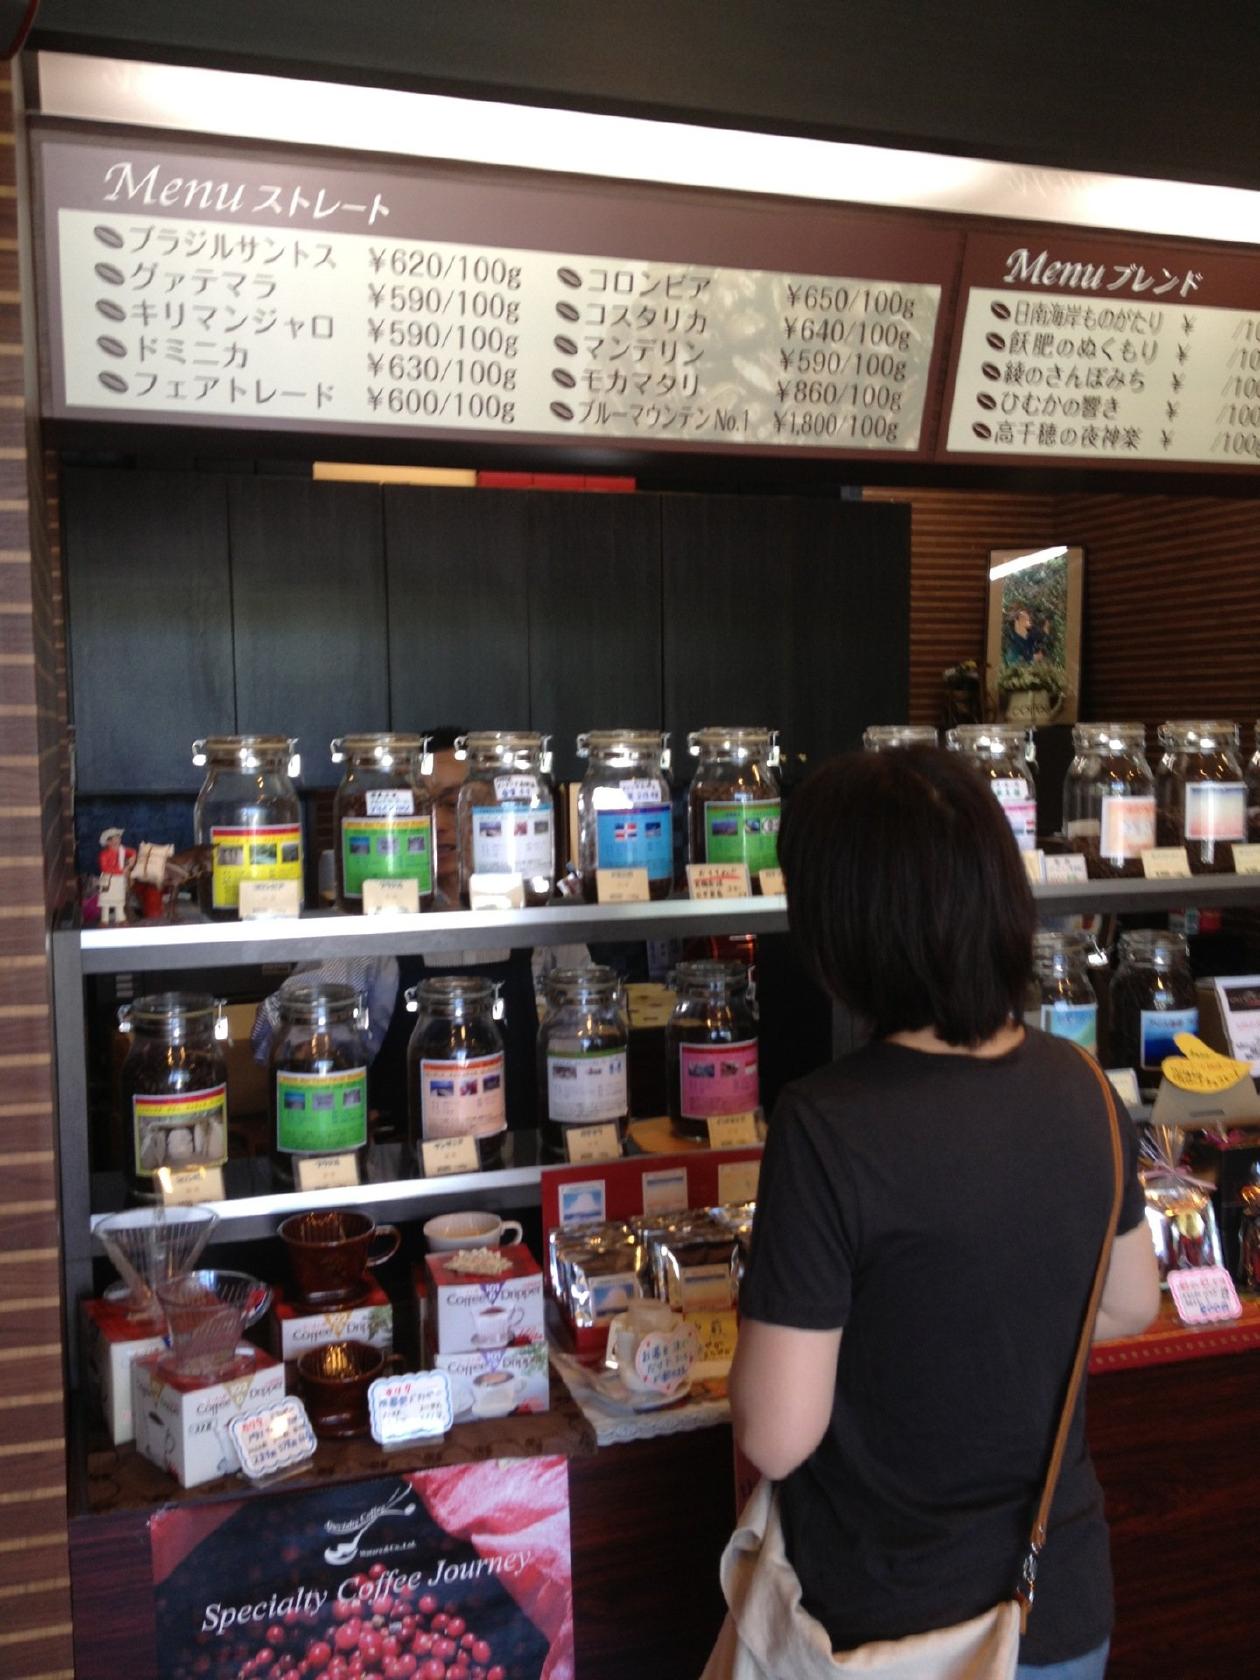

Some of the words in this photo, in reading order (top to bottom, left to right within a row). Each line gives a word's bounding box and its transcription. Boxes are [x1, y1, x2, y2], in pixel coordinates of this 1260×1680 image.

[104, 162, 247, 214] Menu
[252, 184, 390, 225] ストレート
[128, 224, 337, 270] ブラジルサントス
[588, 268, 712, 298] コロンビア
[1003, 248, 1106, 290] Menu
[1106, 263, 1203, 298] ブレンド
[130, 299, 334, 340] キリマンジャロ
[585, 302, 707, 335] コスタリカ
[1182, 312, 1197, 336] ¥
[138, 336, 249, 371] ドミニカ
[583, 336, 705, 367] マンデリン
[1177, 343, 1191, 366] ¥
[133, 371, 335, 409] フェアトレード
[580, 367, 700, 398] モカマタリ
[1171, 371, 1185, 394] ¥
[1166, 399, 1178, 422] ¥
[1160, 429, 1174, 451] ¥
[202, 1587, 329, 1636] Specialty
[337, 1566, 422, 1607] Coffee
[427, 1549, 531, 1586] Journey
